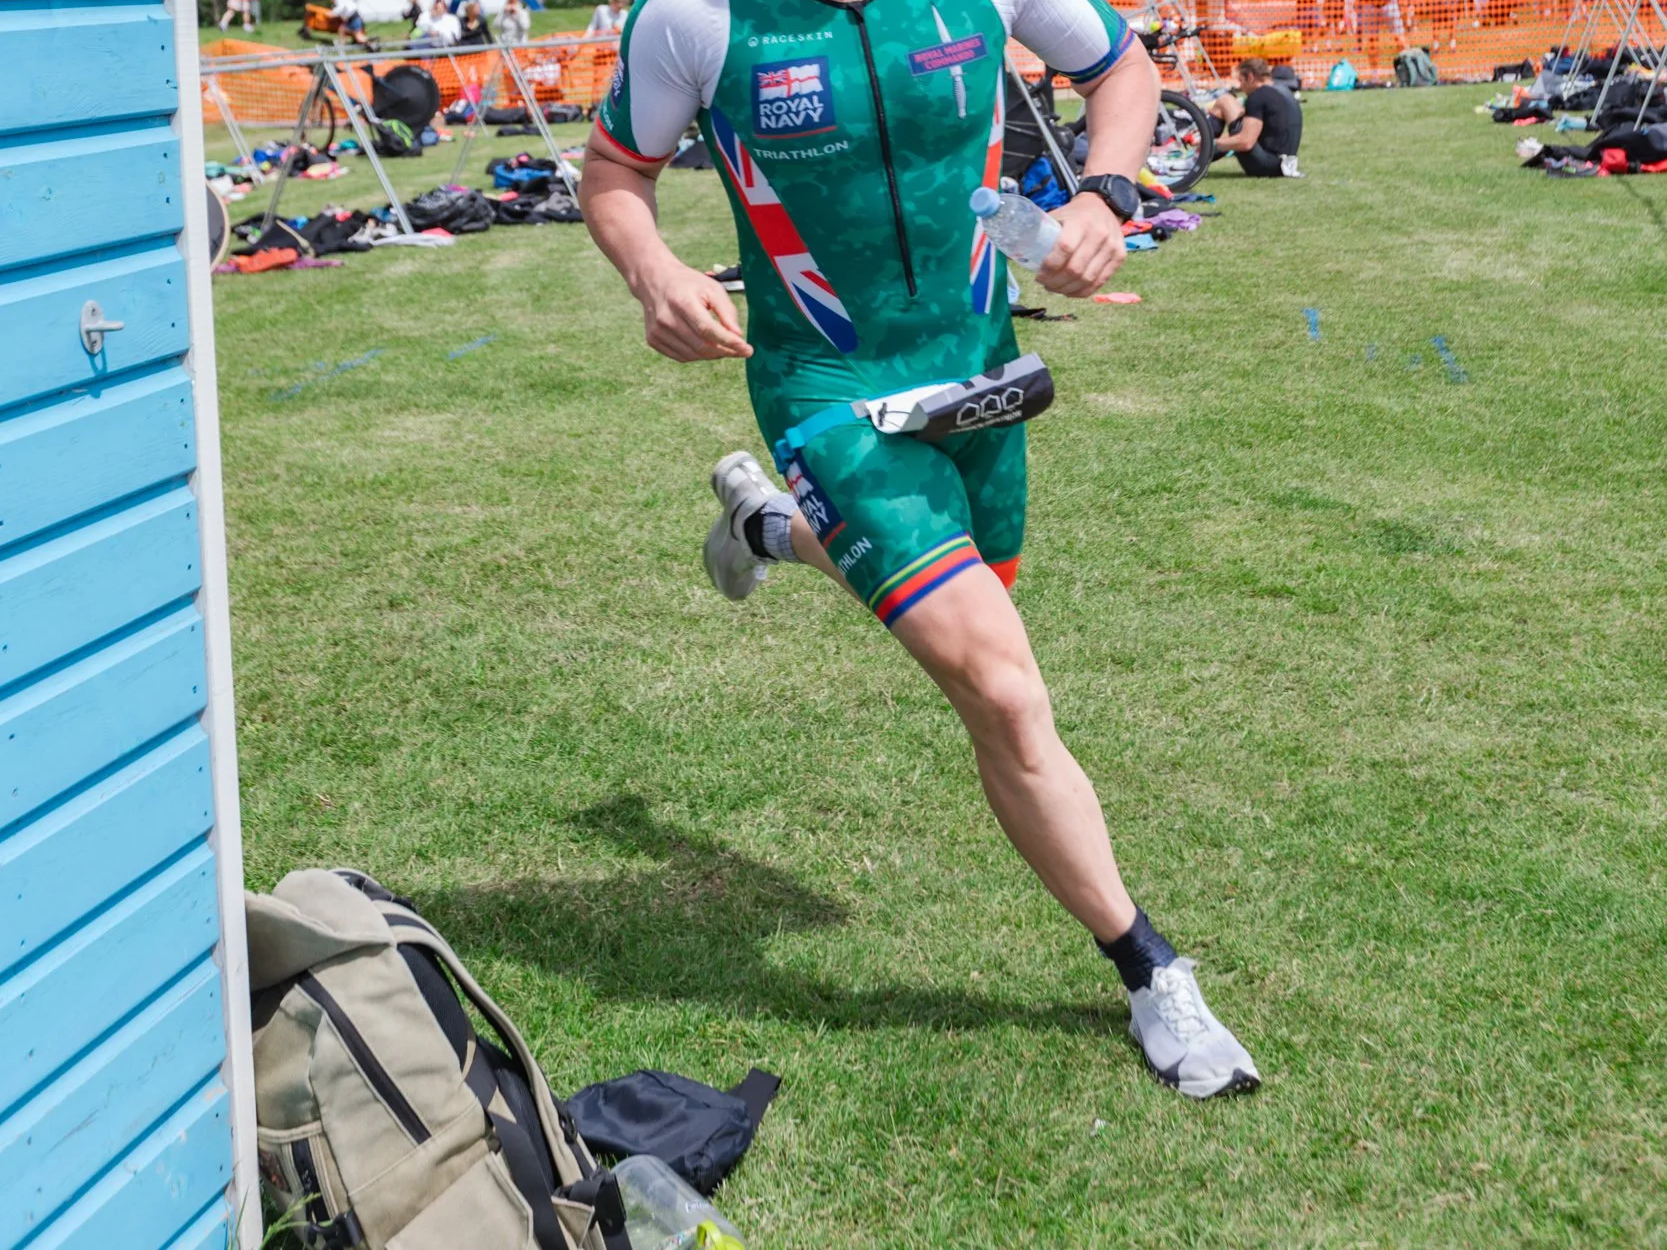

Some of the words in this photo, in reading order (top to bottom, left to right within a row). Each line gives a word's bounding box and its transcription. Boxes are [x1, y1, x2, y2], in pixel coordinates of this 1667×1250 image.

[762, 31, 833, 45] RACESKIN
[759, 95, 824, 116] ROYAL
[760, 107, 824, 129] NAVY
[753, 140, 849, 160] TRIATHLON
